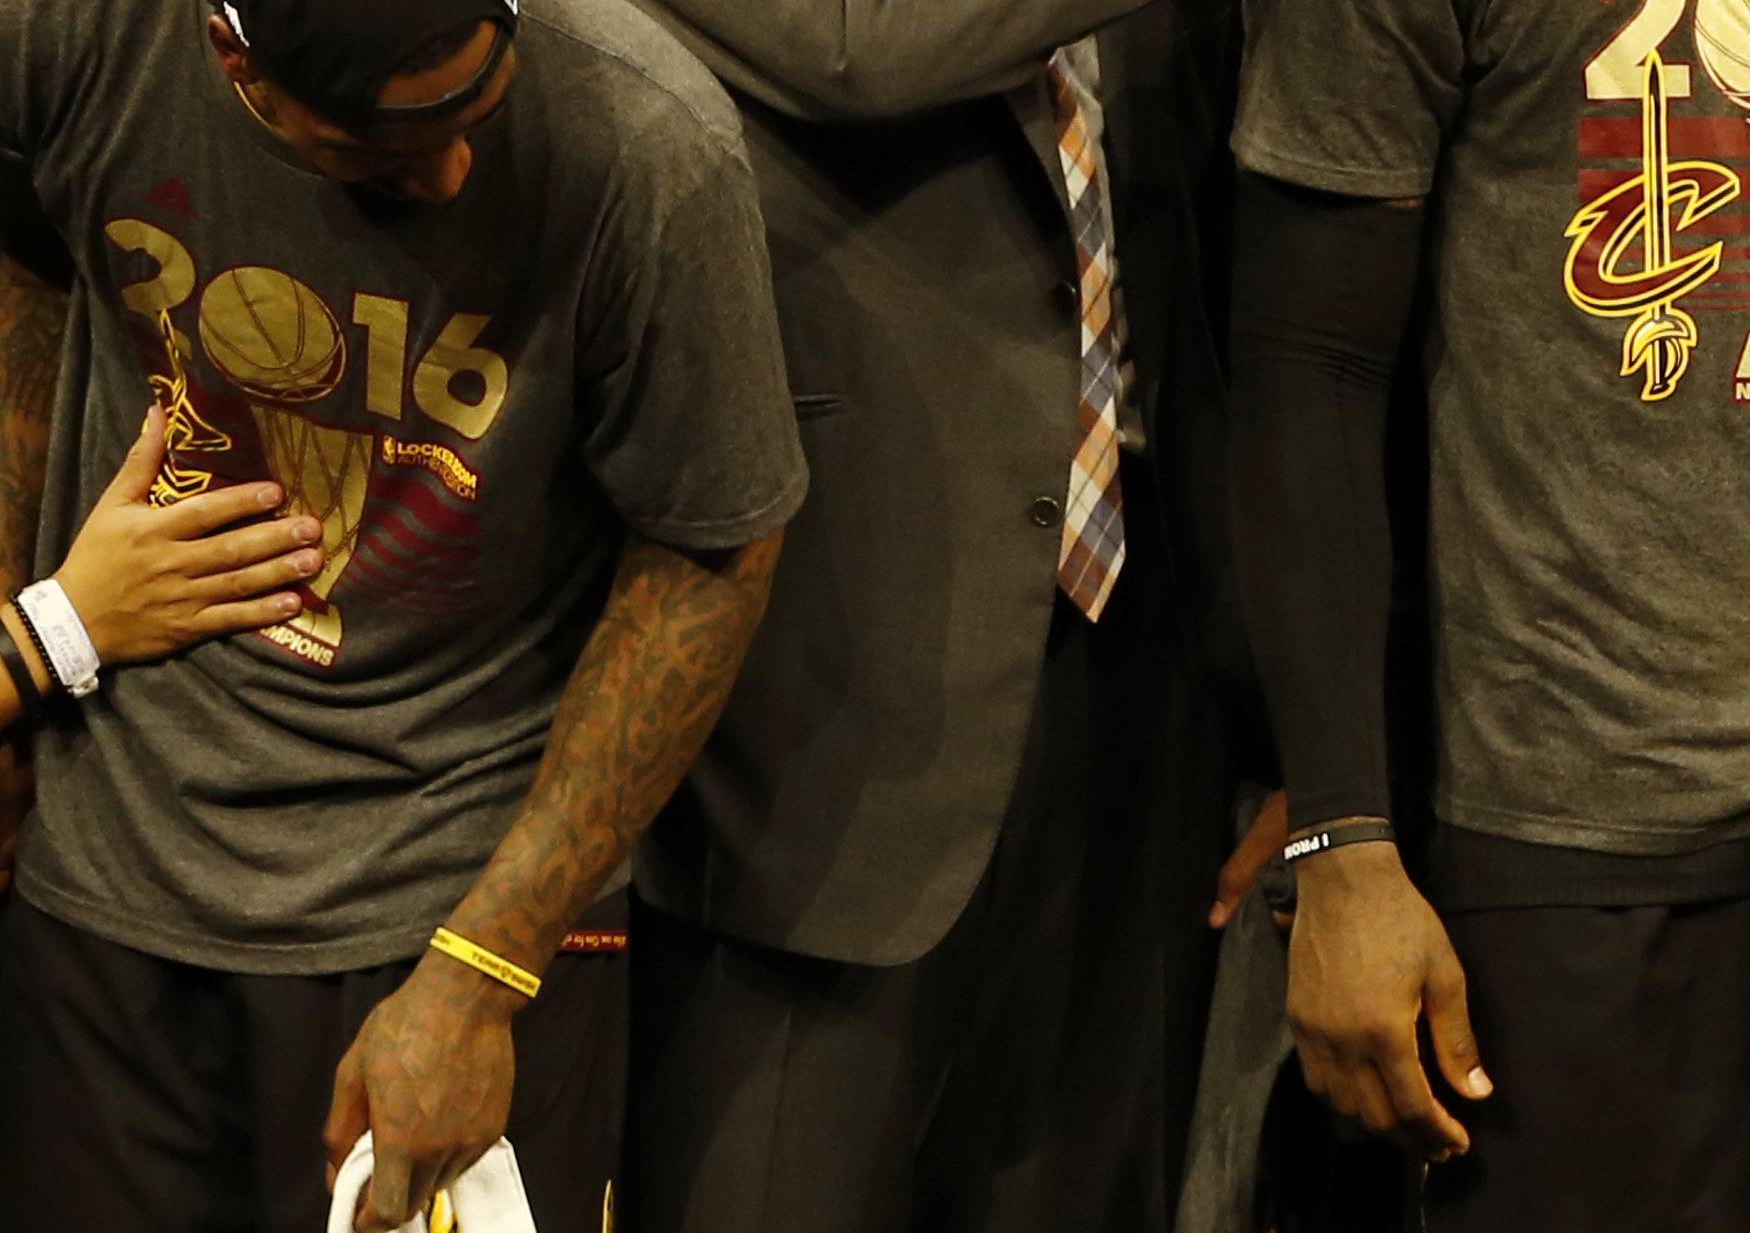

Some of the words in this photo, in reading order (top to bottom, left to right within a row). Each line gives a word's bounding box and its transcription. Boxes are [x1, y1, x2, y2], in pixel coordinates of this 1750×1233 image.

[104, 209, 509, 441] 2016
[260, 625, 335, 667] MPIONS
[1321, 832, 1330, 847] I
